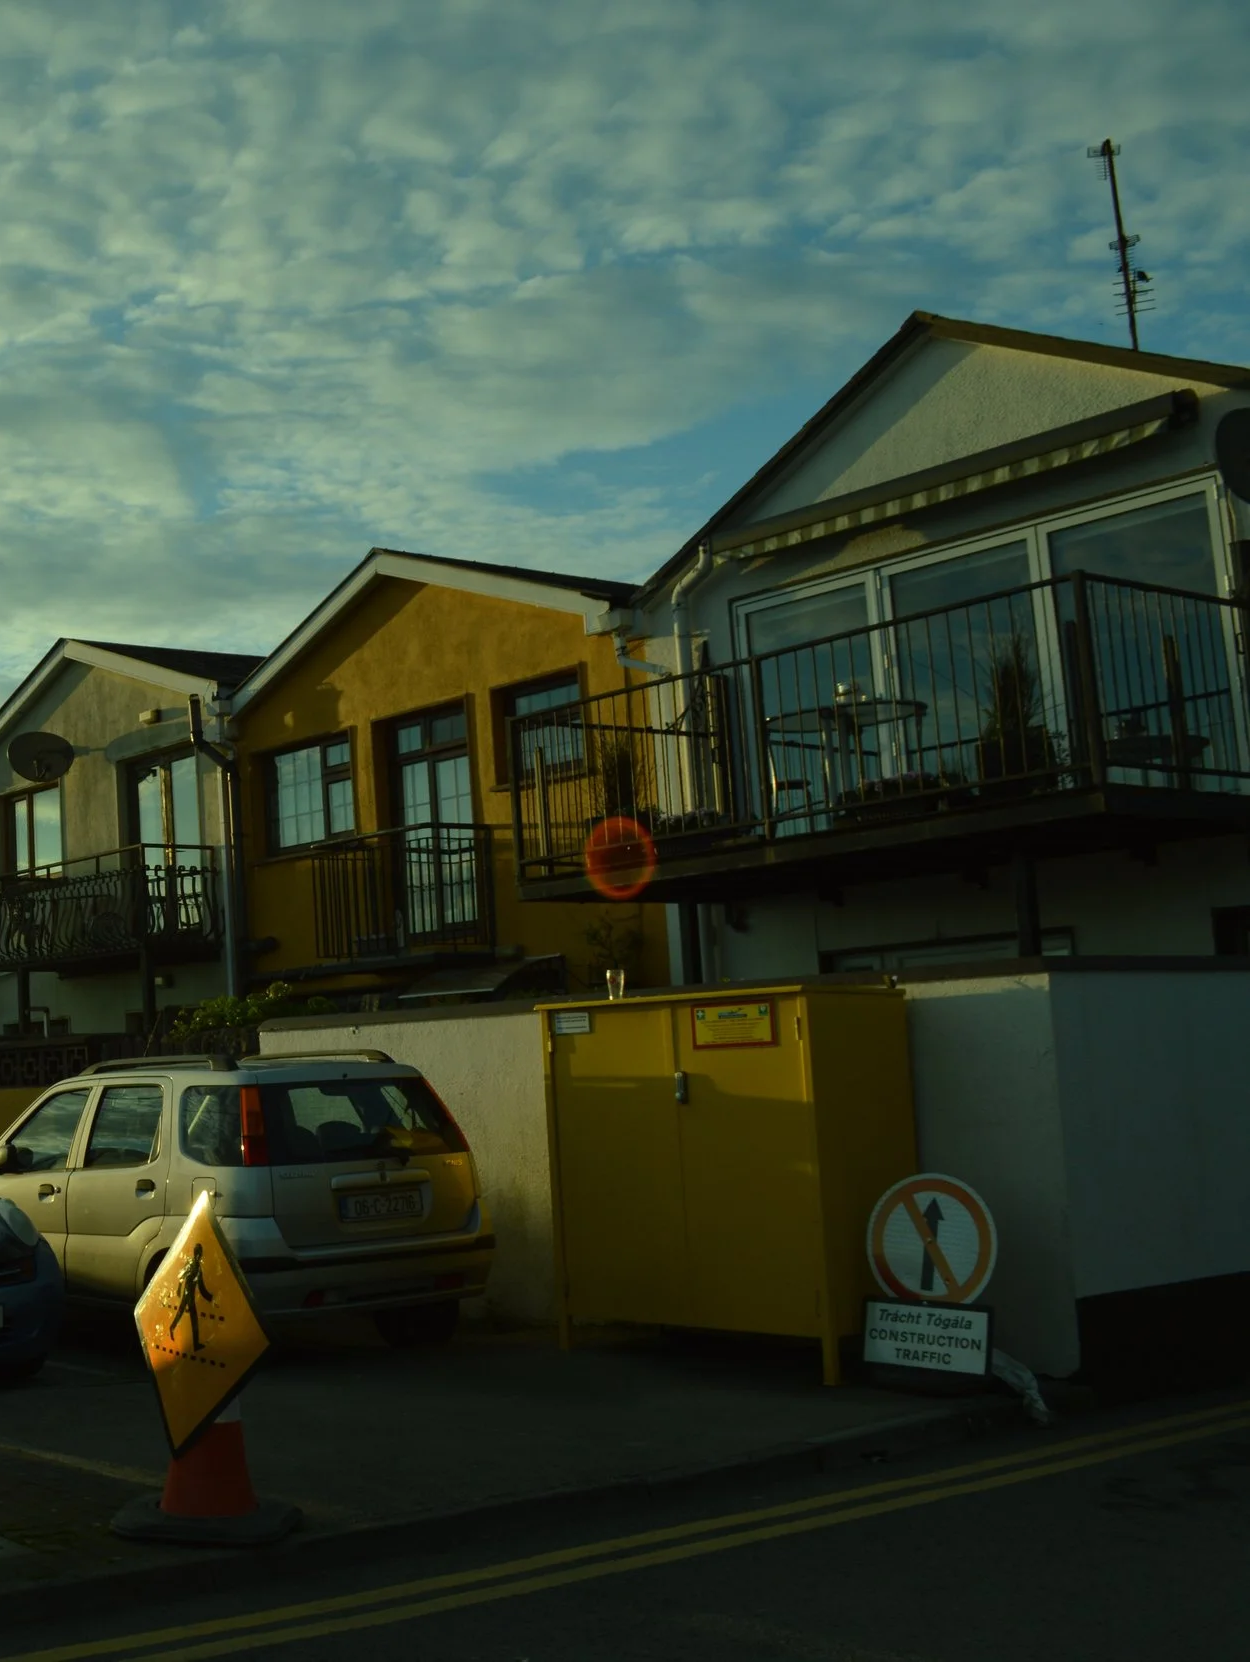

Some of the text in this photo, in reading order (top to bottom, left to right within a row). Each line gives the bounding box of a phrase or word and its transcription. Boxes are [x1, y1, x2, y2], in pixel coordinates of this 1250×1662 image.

[879, 1308, 973, 1330] Trácht Tógála
[869, 1328, 982, 1351] CONSTRUCTION
[895, 1348, 952, 1365] TRAFFIC
